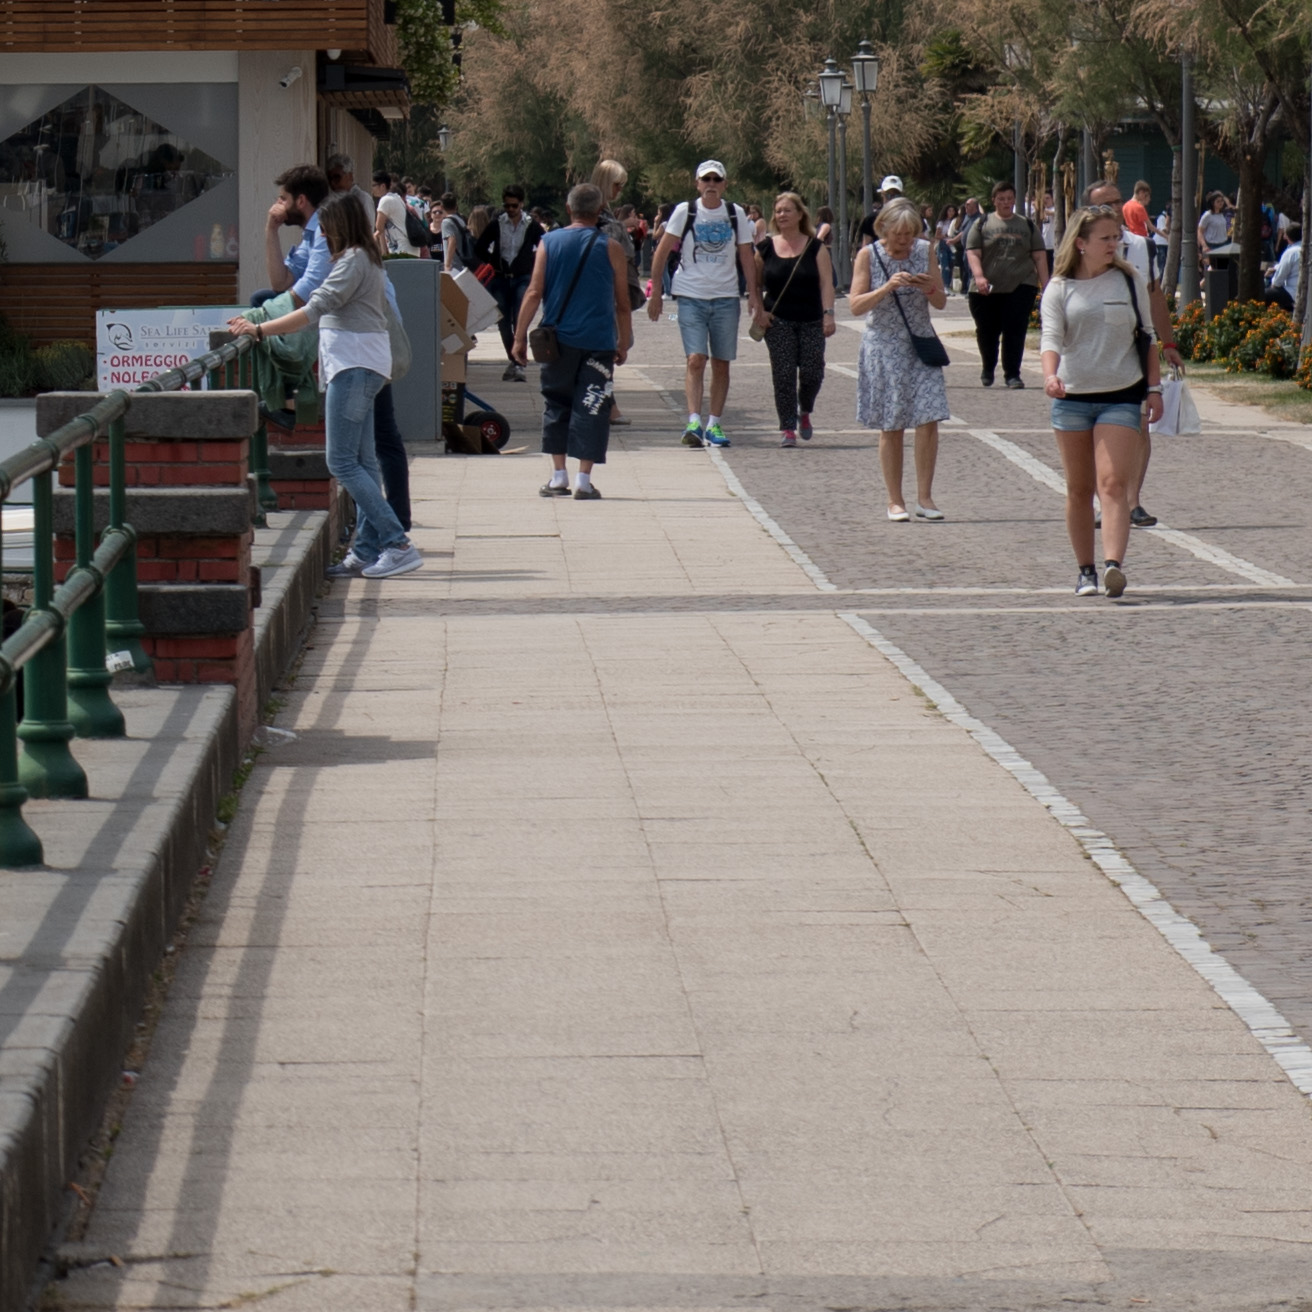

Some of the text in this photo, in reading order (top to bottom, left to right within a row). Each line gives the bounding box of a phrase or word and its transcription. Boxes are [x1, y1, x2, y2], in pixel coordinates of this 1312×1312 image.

[141, 326, 161, 336] SEA
[166, 325, 189, 336] LIFE
[110, 354, 189, 368] ORMEGGIO
